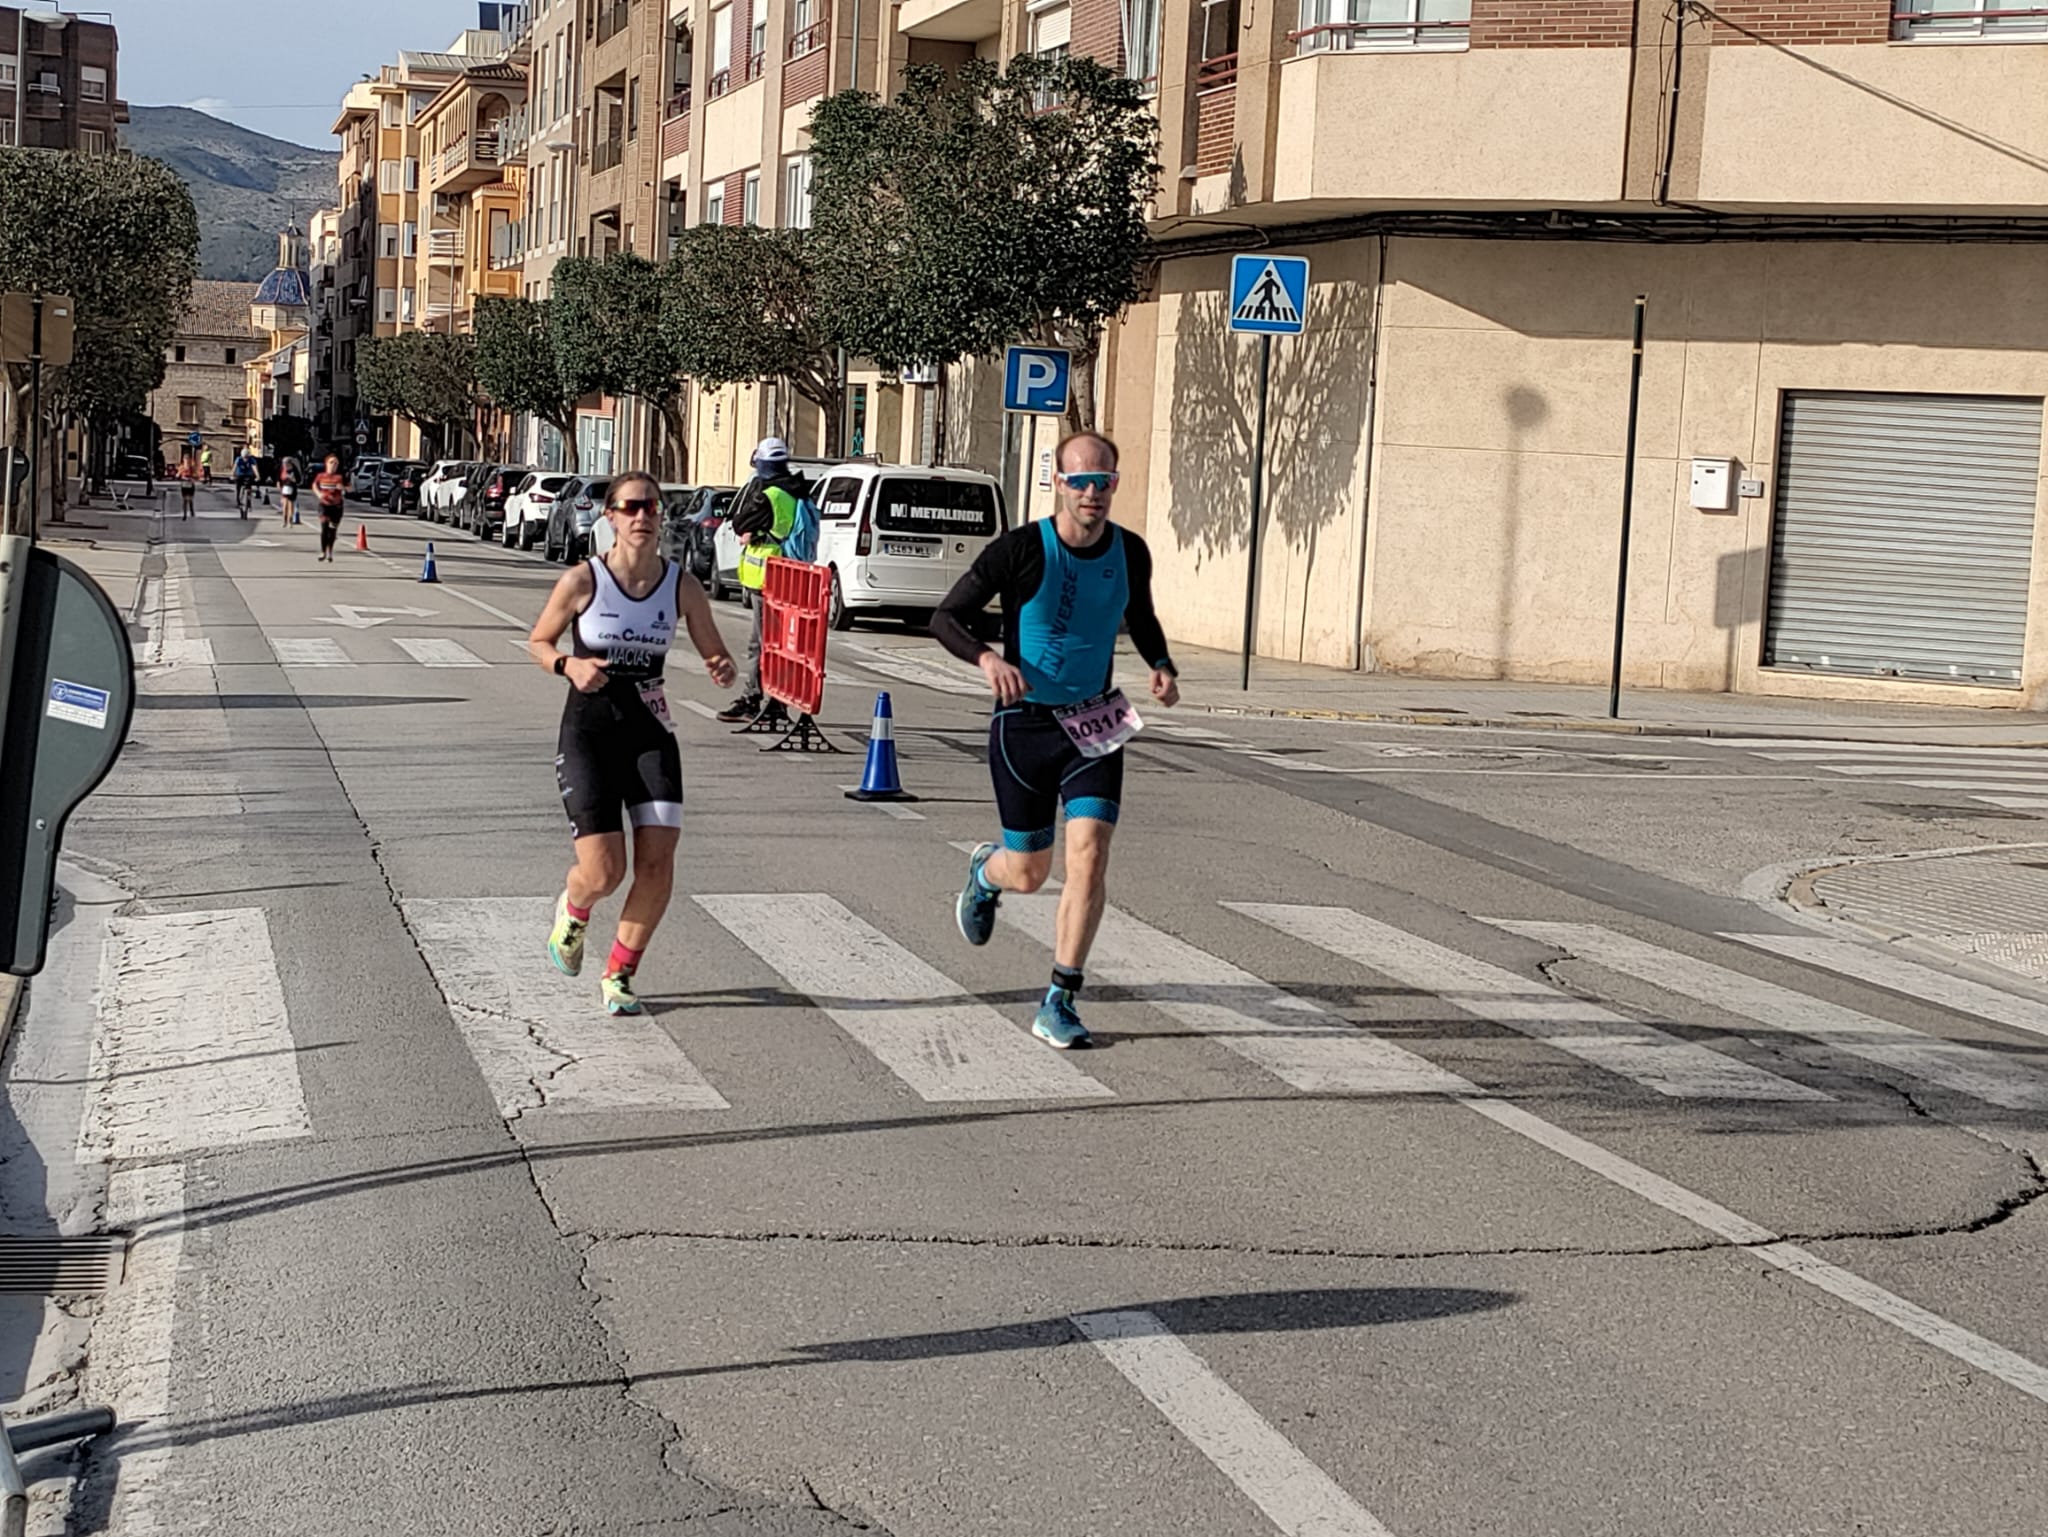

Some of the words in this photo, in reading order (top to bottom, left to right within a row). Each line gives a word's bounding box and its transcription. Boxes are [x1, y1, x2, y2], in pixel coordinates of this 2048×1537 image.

[1016, 354, 1057, 405] P
[910, 506, 985, 523] METALINOX
[1067, 707, 1129, 740] B031A
